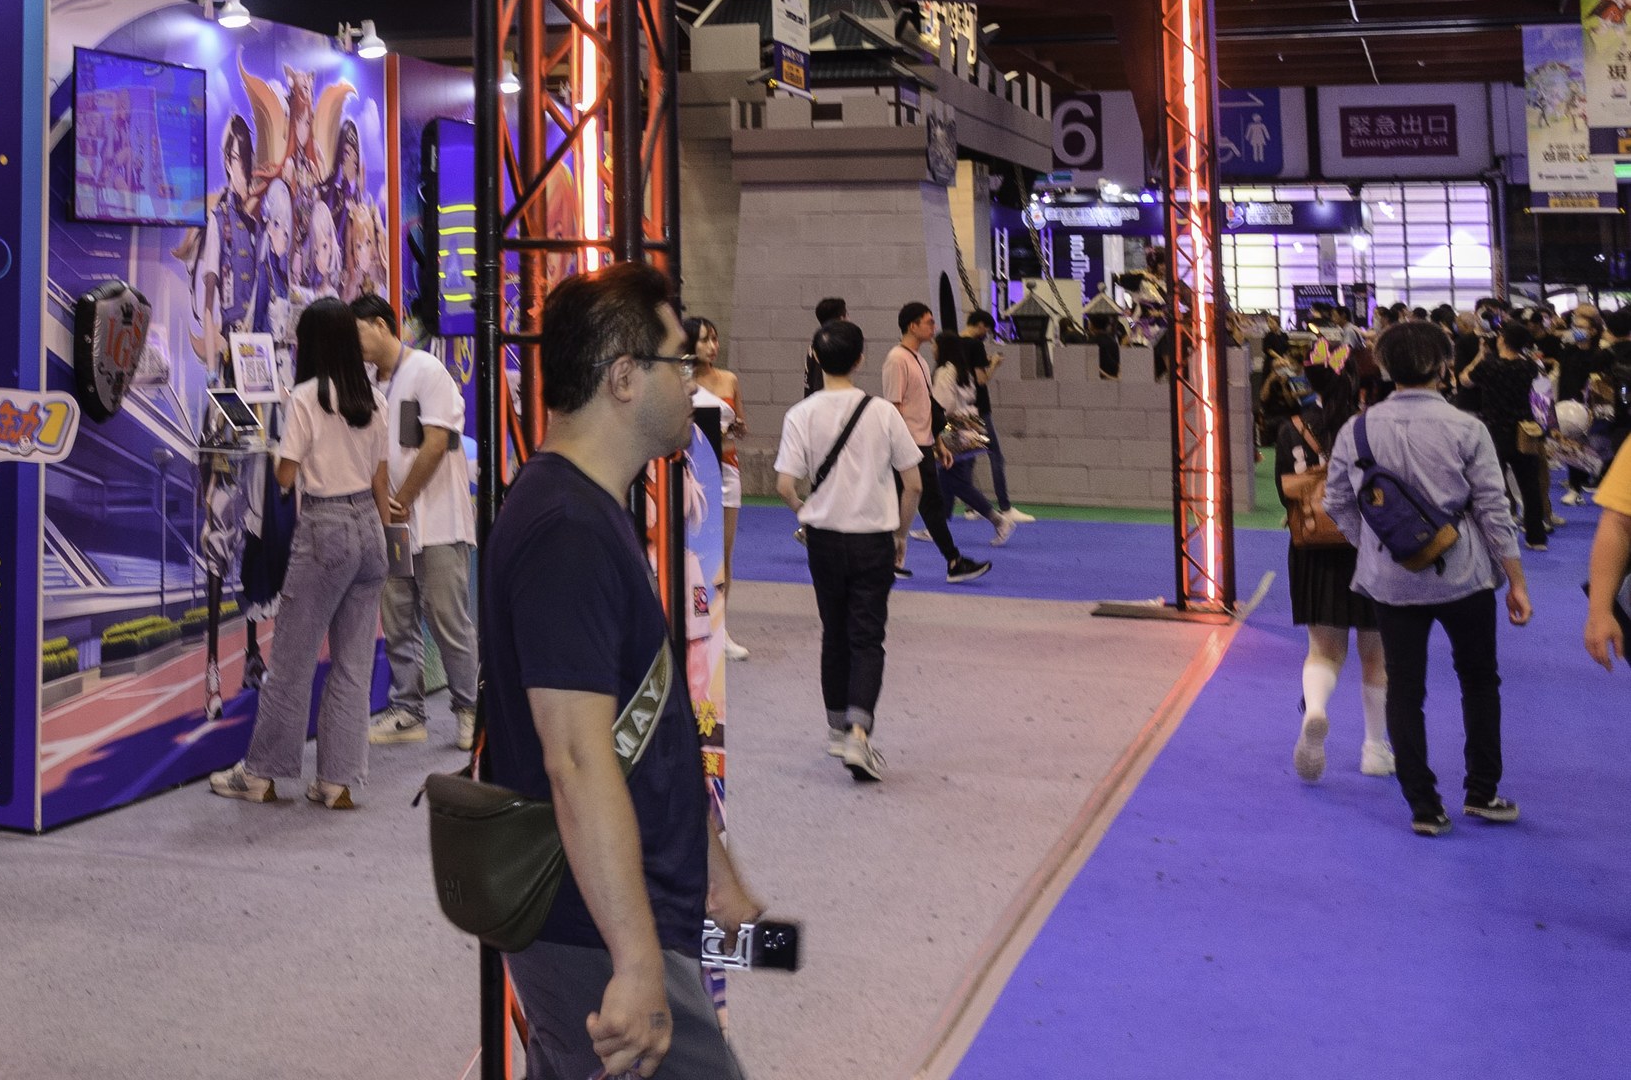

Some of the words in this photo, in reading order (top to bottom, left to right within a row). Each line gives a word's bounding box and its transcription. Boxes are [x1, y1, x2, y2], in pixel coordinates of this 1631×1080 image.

[1052, 100, 1098, 166] 6
[1348, 114, 1450, 136] 緊急出口
[1349, 136, 1420, 149] Emergency
[1423, 135, 1449, 147] Exit
